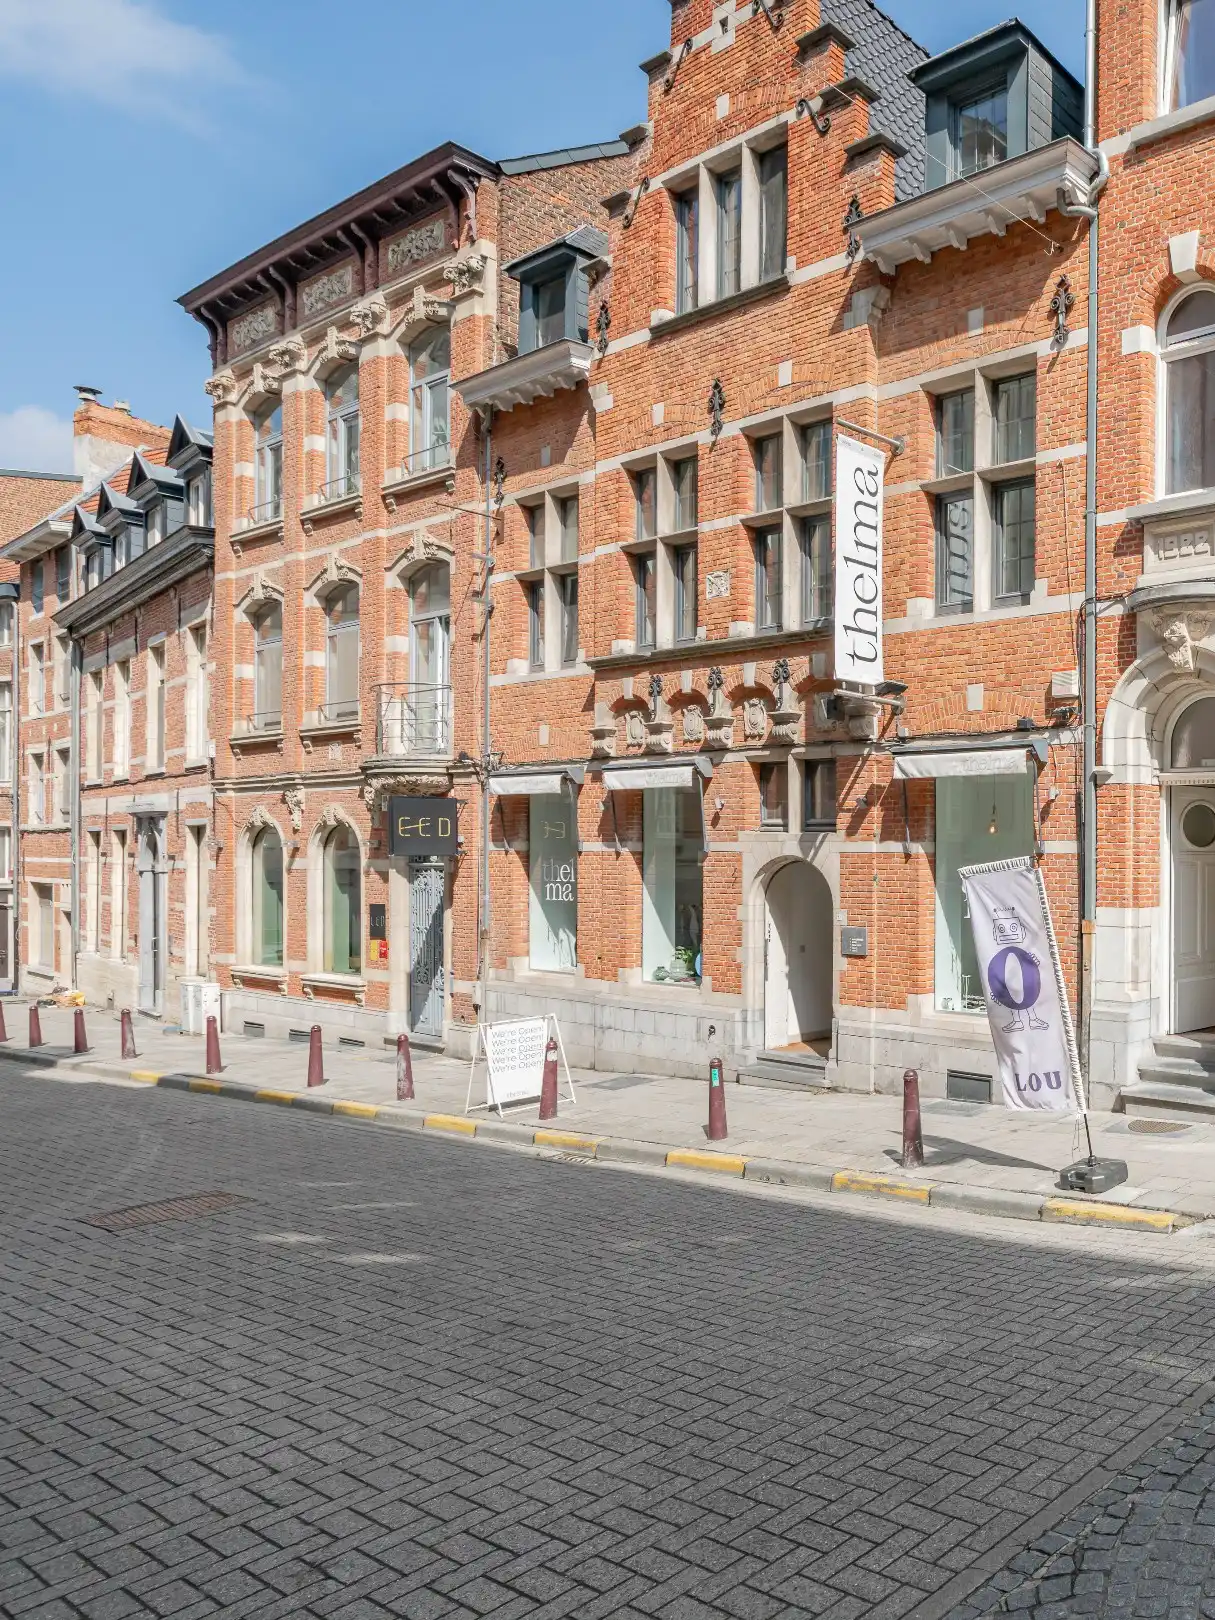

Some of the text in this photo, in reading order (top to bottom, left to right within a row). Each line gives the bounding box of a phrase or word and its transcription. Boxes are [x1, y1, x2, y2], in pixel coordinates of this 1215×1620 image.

[843, 463, 879, 666] thelma
[542, 858, 575, 882] thel
[544, 882, 575, 902] ma
[1015, 1070, 1062, 1092] LOU
